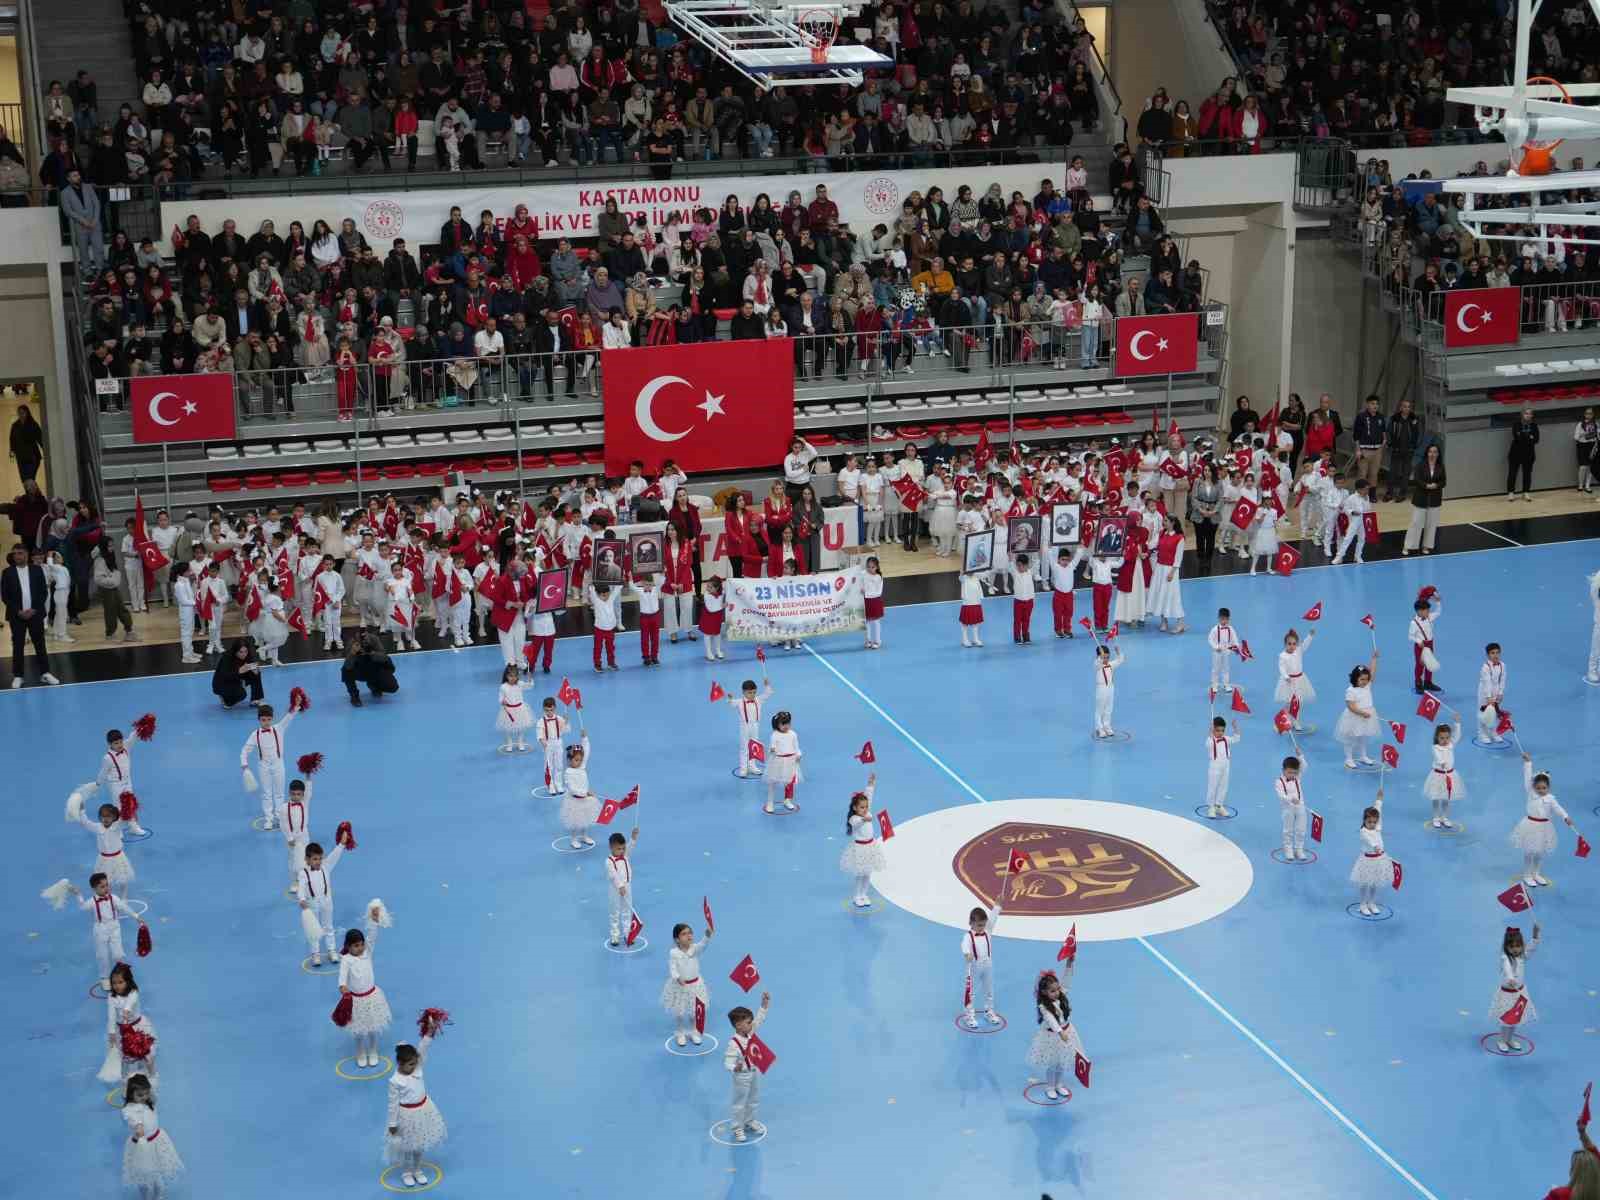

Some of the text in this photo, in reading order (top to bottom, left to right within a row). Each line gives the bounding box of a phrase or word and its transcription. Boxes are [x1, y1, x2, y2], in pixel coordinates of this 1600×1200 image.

[579, 186, 700, 206] KASTAMONU
[568, 214, 592, 230] VE
[755, 587, 772, 600] 23
[1000, 832, 1053, 844] 1976
